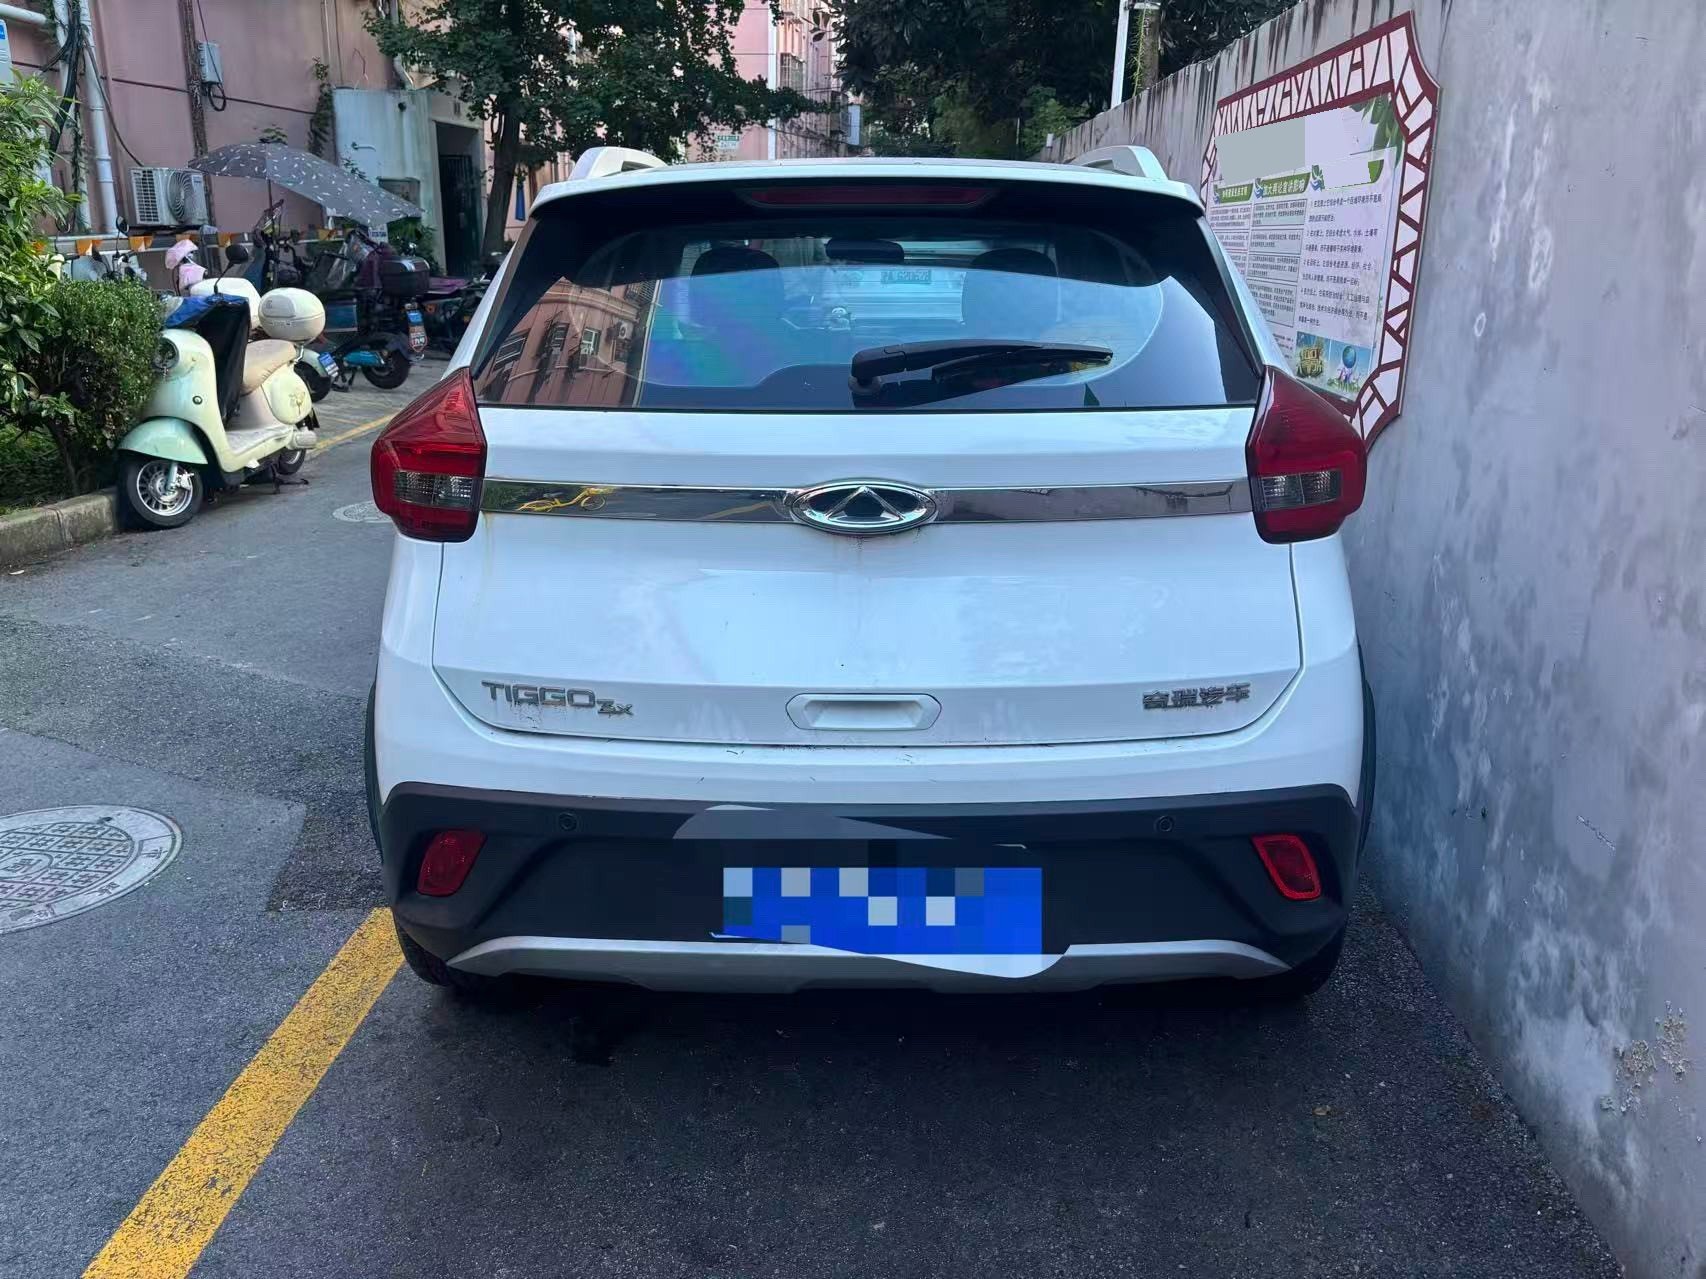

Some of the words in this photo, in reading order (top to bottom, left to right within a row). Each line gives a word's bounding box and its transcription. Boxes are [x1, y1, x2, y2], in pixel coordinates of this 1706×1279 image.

[481, 680, 596, 707] TIGGO
[1142, 682, 1251, 710] 奇瑞汽车
